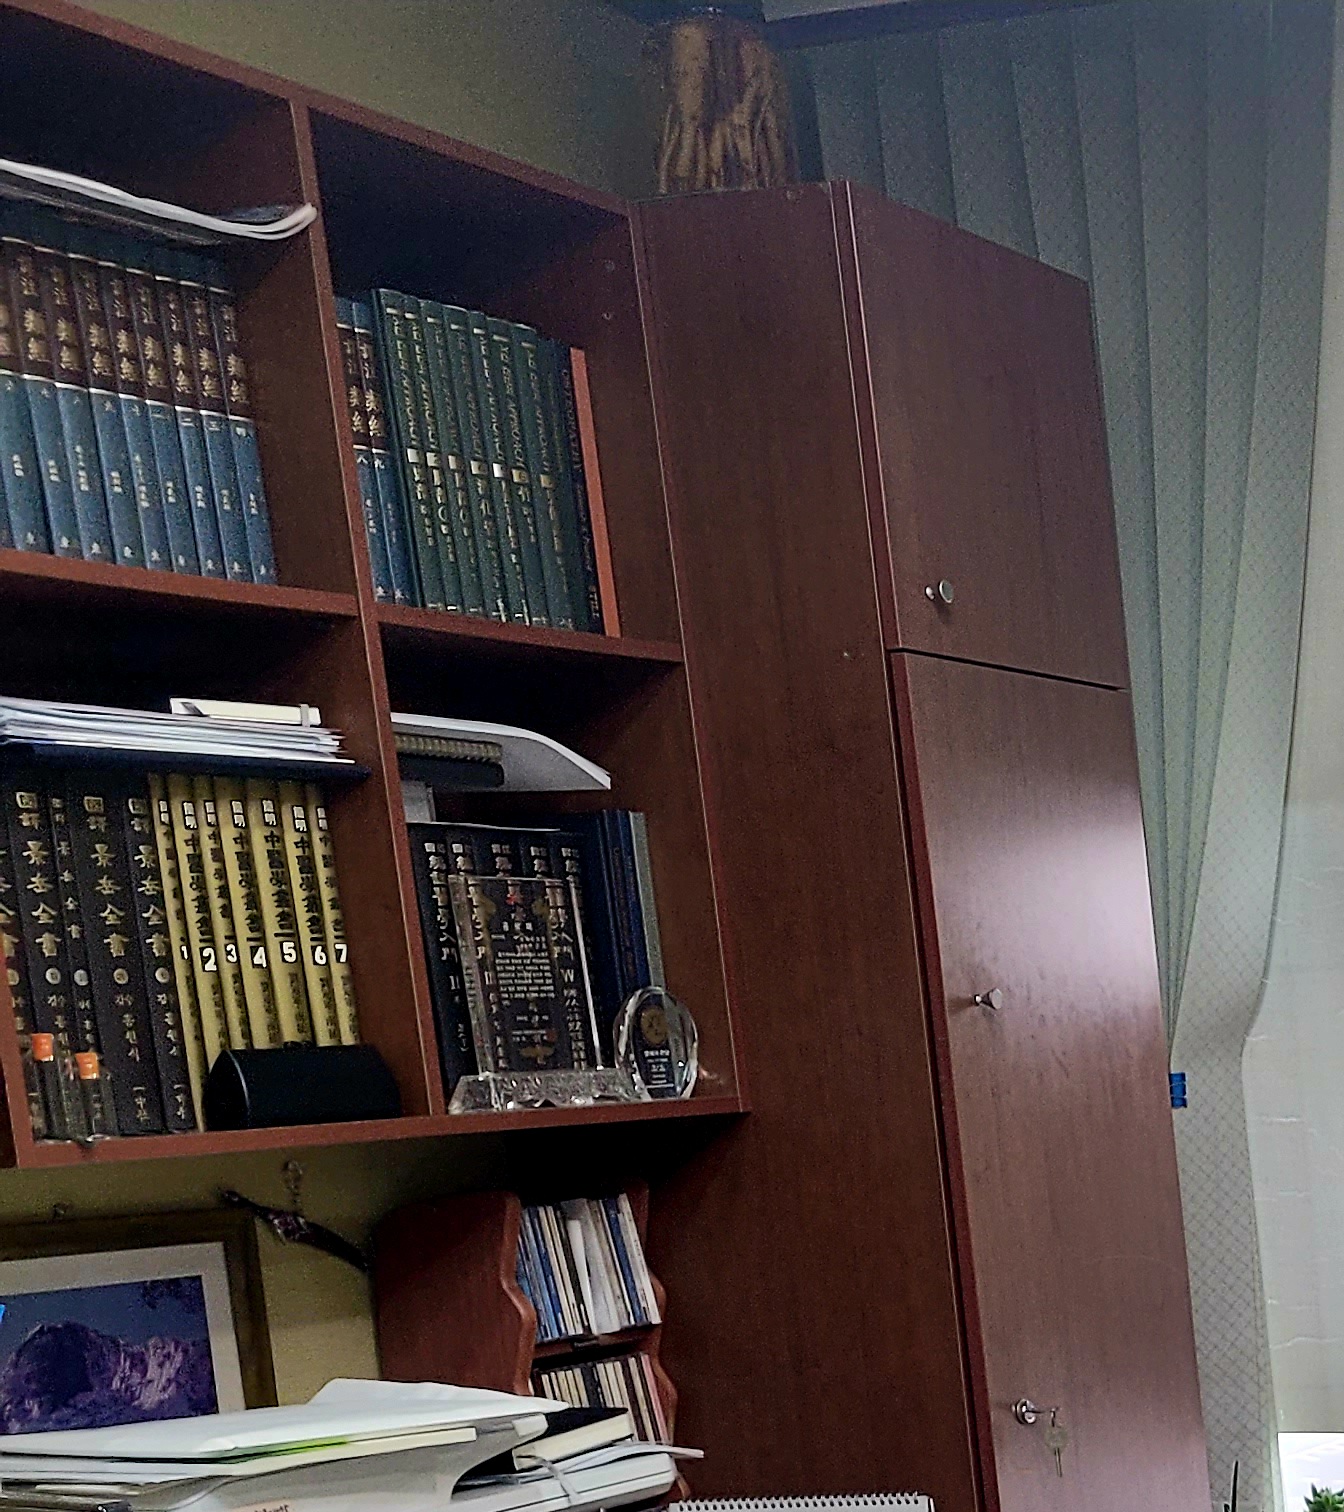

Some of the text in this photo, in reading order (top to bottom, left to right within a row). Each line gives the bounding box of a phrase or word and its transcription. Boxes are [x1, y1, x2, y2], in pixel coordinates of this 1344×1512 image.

[179, 945, 189, 960] 1
[202, 946, 218, 972] 2
[226, 943, 238, 963] 3
[252, 945, 267, 968] 4
[281, 941, 297, 963] 5
[314, 945, 327, 966] 6
[334, 942, 348, 964] 7
